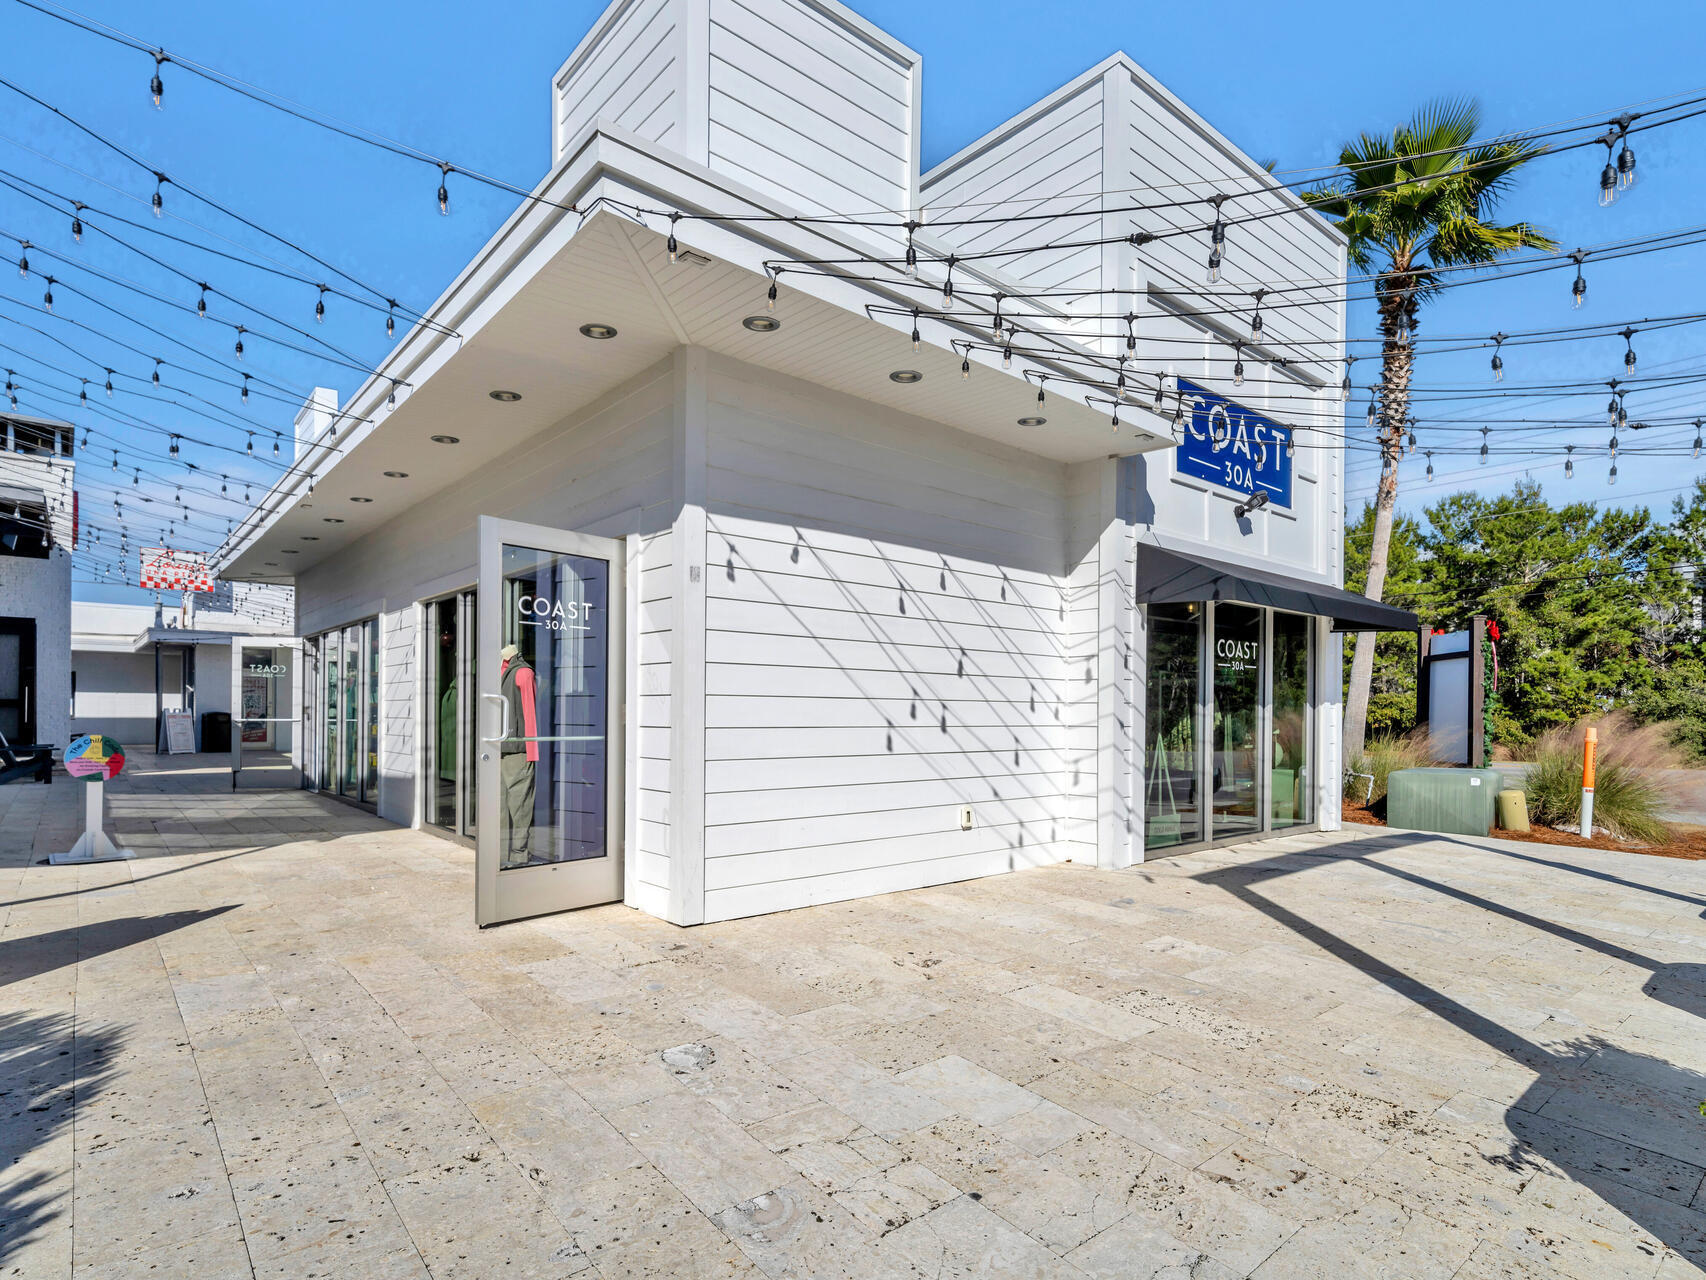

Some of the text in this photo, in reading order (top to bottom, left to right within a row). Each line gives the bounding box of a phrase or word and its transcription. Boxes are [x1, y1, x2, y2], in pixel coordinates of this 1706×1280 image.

[1186, 395, 1285, 471] COAST
[1225, 461, 1254, 490] 30A
[518, 595, 592, 621] COAST
[545, 620, 567, 631] 30A
[1217, 638, 1258, 660] COAST
[1231, 661, 1244, 671] 30A
[69, 743, 83, 755] The
